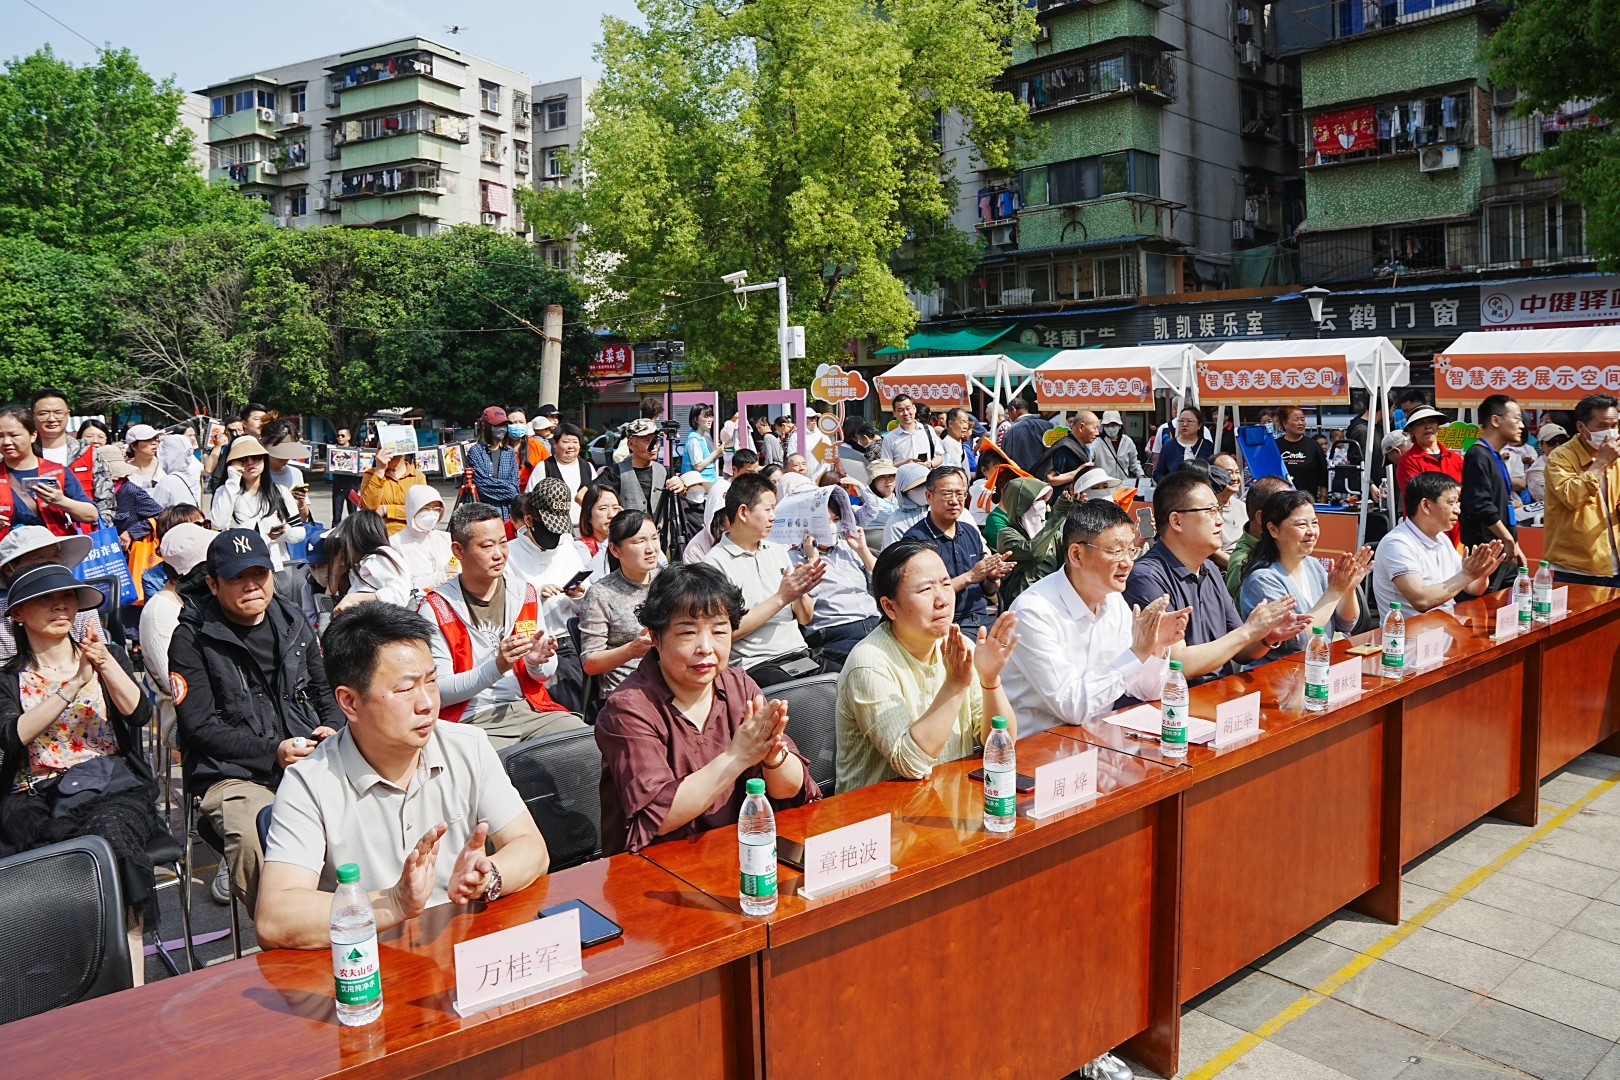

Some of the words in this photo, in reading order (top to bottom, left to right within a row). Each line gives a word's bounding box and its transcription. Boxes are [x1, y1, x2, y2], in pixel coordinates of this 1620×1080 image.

[1320, 298, 1460, 332] 云鹤门窗
[1153, 310, 1264, 340] 凯凯娱乐室
[1207, 370, 1335, 387] 智慧养老展示空间
[1449, 368, 1620, 387] 智慧养老展示空间
[1043, 380, 1142, 395] 智慧养老展示空间
[82, 542, 121, 563] 防诈骗
[232, 535, 252, 554] NY
[819, 838, 878, 876] 章艳波
[339, 963, 374, 978] 农夫山泉
[475, 942, 561, 993] 万桂军
[340, 979, 376, 993] 饮用纯净水
